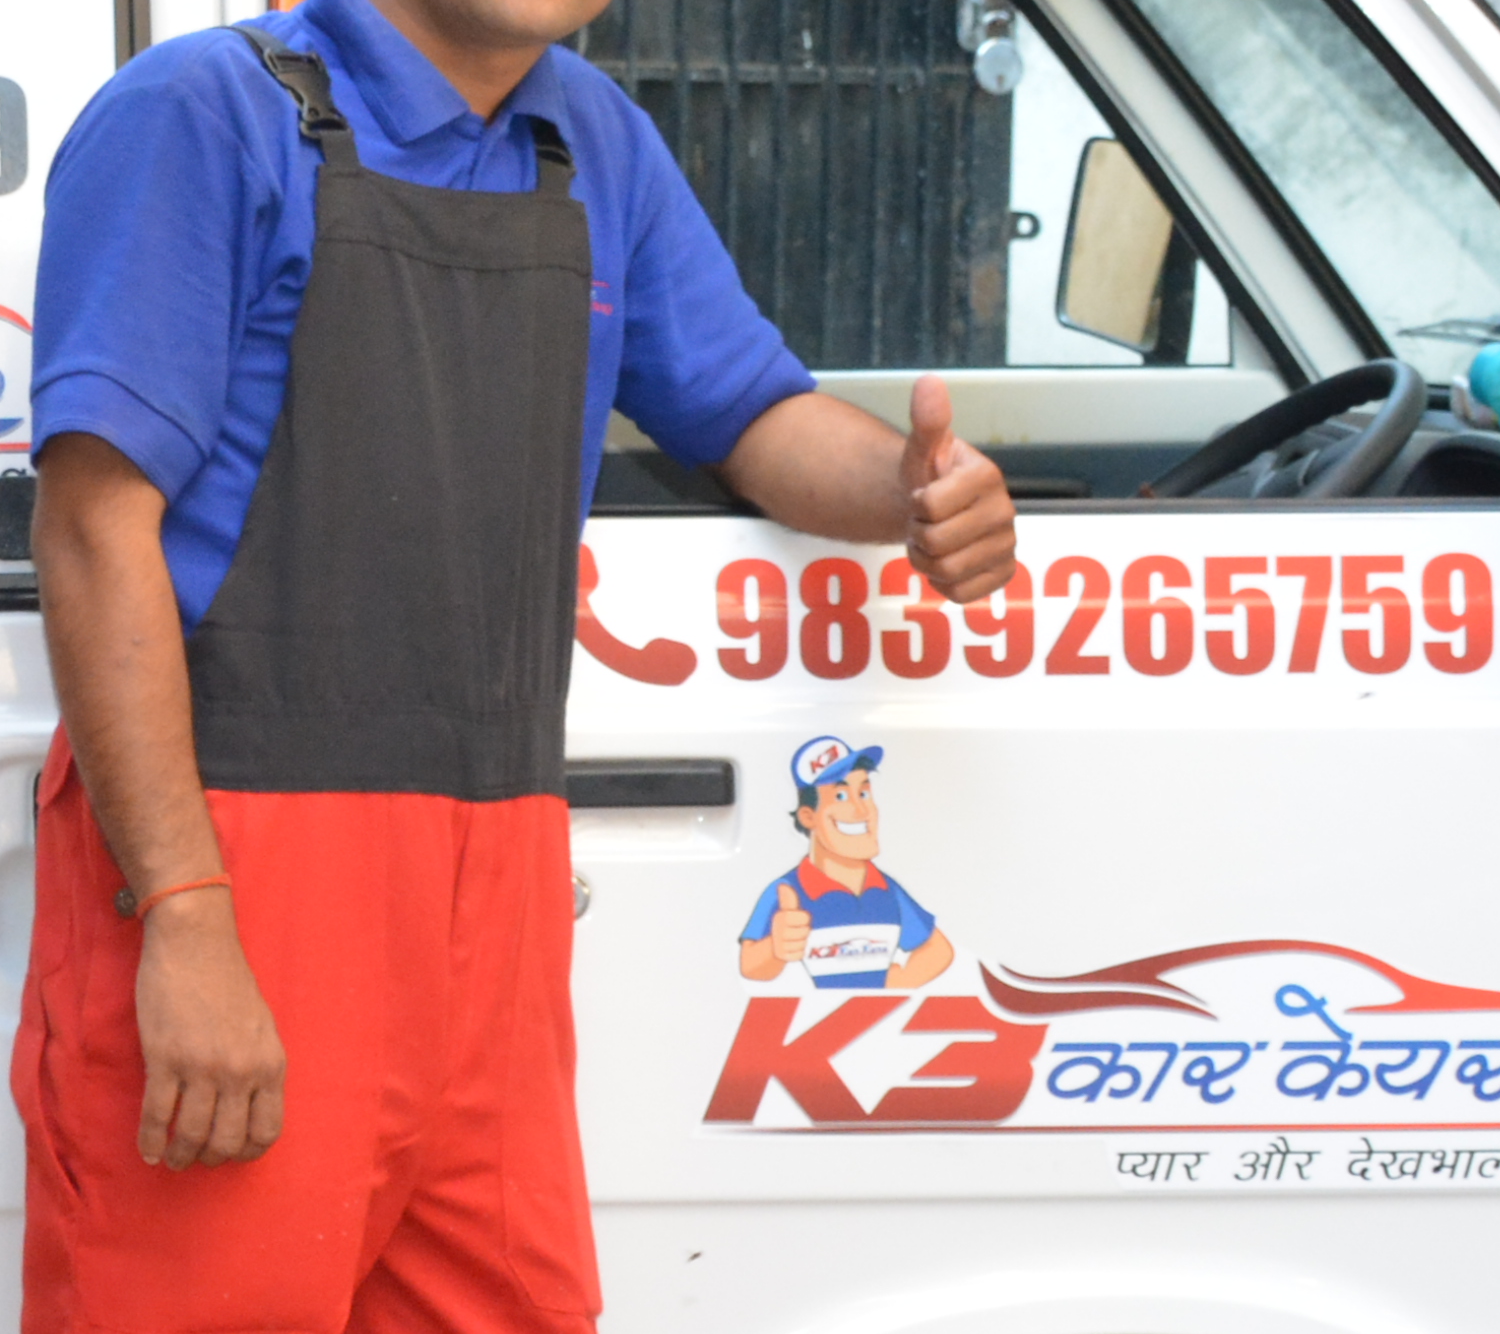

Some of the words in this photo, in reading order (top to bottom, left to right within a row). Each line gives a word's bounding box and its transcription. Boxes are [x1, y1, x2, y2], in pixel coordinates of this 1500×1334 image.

[715, 552, 1494, 681] 9839265759
[810, 744, 840, 774] K3
[702, 996, 1052, 1125] K3
[1046, 1040, 1269, 1105] कार
[1116, 1150, 1210, 1182] प्यार
[1233, 1136, 1322, 1181] और
